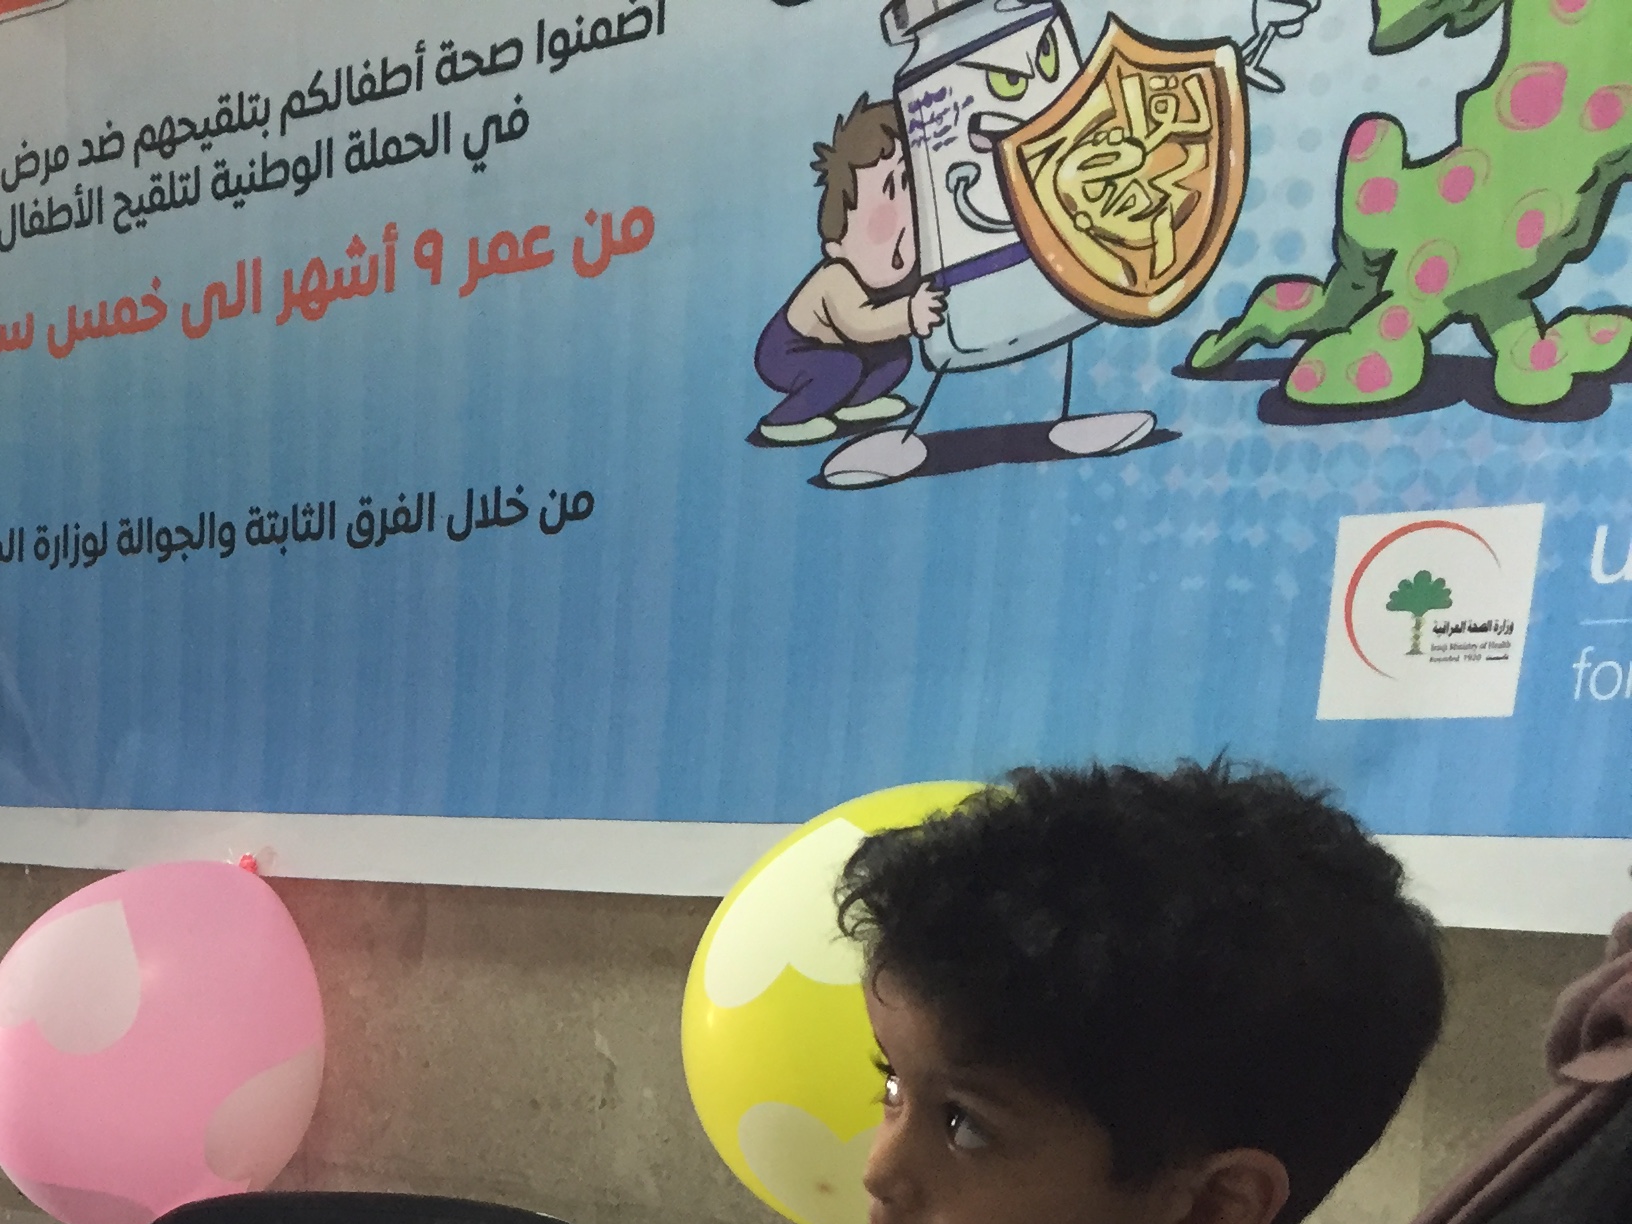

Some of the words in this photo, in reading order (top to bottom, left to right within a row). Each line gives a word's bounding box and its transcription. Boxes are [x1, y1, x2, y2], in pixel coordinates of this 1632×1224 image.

[280, 40, 425, 136] أطفالكم
[435, 37, 523, 86] صحة
[78, 120, 125, 167] ضد
[134, 90, 271, 168] بتلقيحهم
[345, 110, 452, 174] الحملة
[463, 92, 530, 173] في
[1, 140, 69, 193] مرض
[211, 137, 334, 209] الوطنية
[113, 165, 201, 234] لتلقيح
[275, 221, 400, 326] أشهر
[413, 227, 444, 286] ٩
[458, 225, 555, 299] عمر
[573, 205, 656, 279] من
[47, 276, 168, 360] خمس
[181, 256, 263, 340] الى
[117, 511, 236, 564] والجوالة
[245, 500, 336, 556] الثابتة
[346, 491, 436, 549] الفرق
[446, 484, 530, 542] خلال
[539, 488, 596, 535] من
[33, 520, 108, 571] لوزارة
